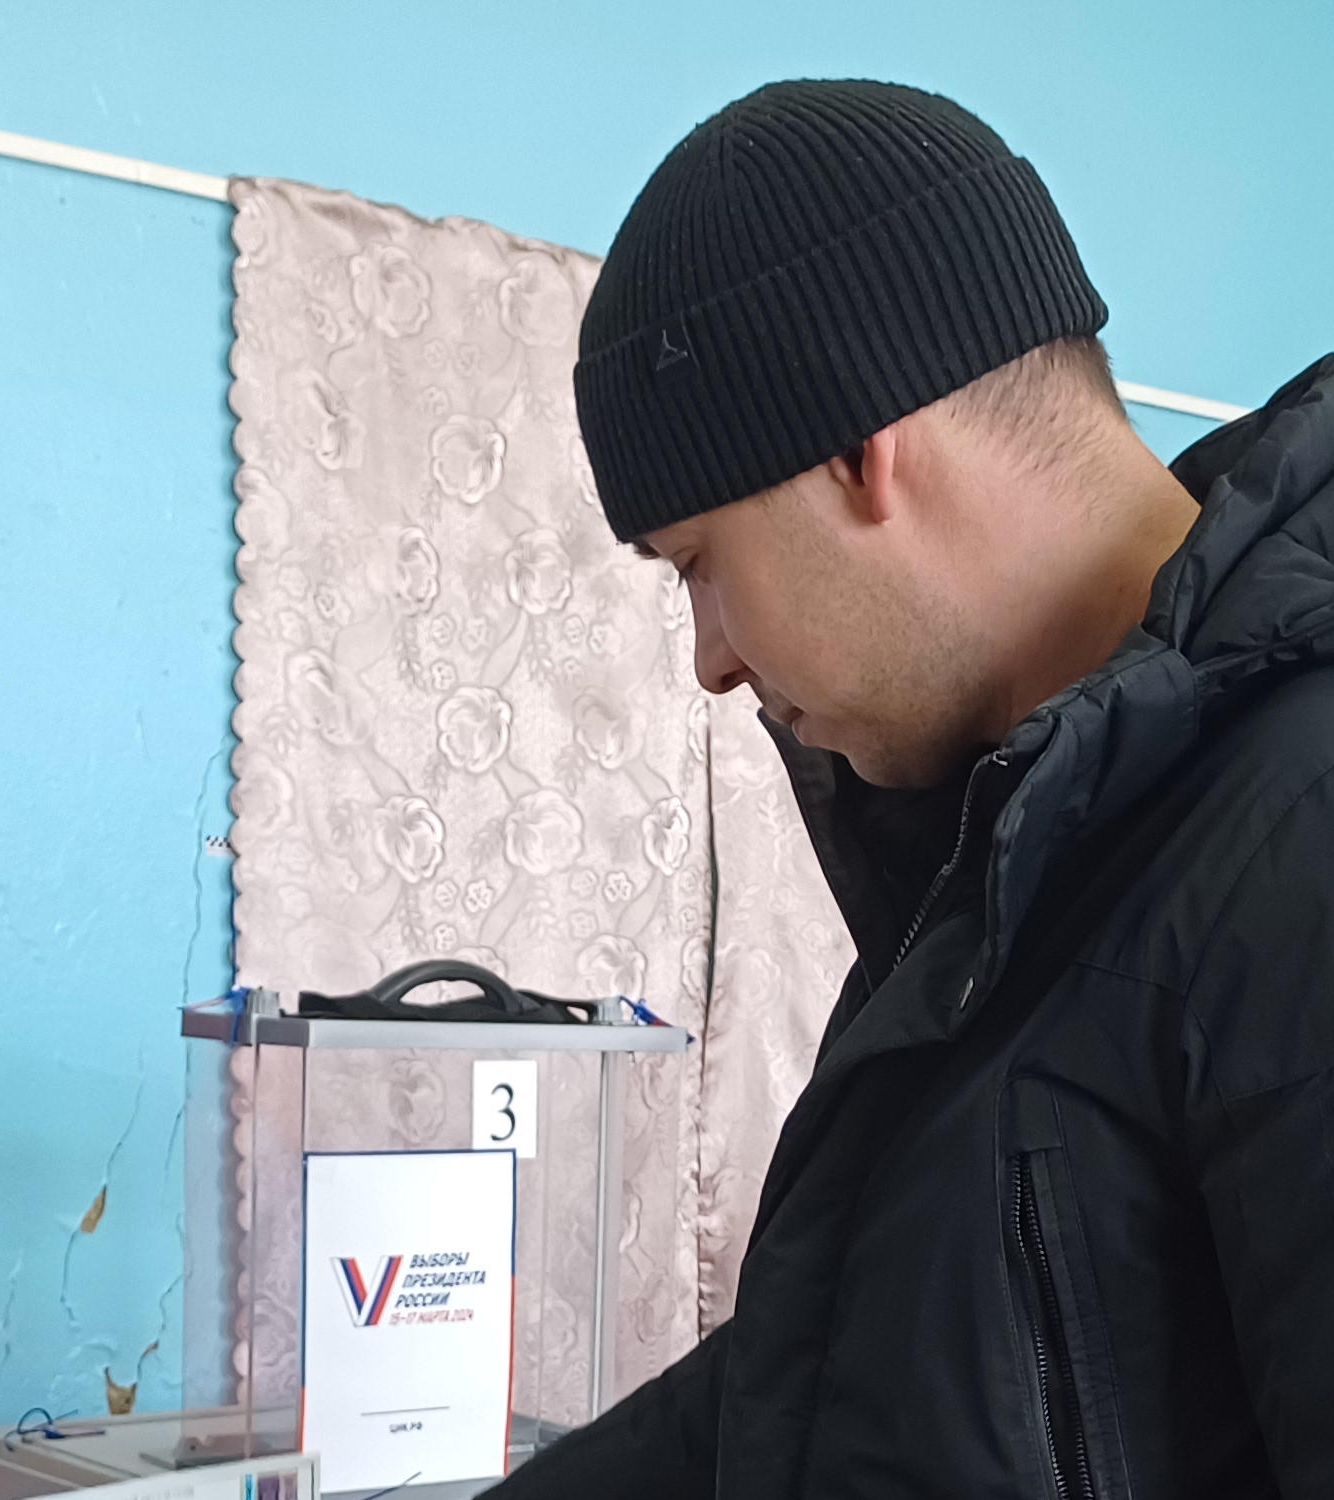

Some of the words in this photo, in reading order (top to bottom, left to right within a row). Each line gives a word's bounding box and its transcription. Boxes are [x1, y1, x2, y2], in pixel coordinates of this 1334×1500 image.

[490, 1082, 516, 1141] 3
[409, 1252, 470, 1269] ВЫБОРЫ
[402, 1270, 487, 1288] ПРЕЗИДЕНТА
[394, 1292, 451, 1309] РОССИИ
